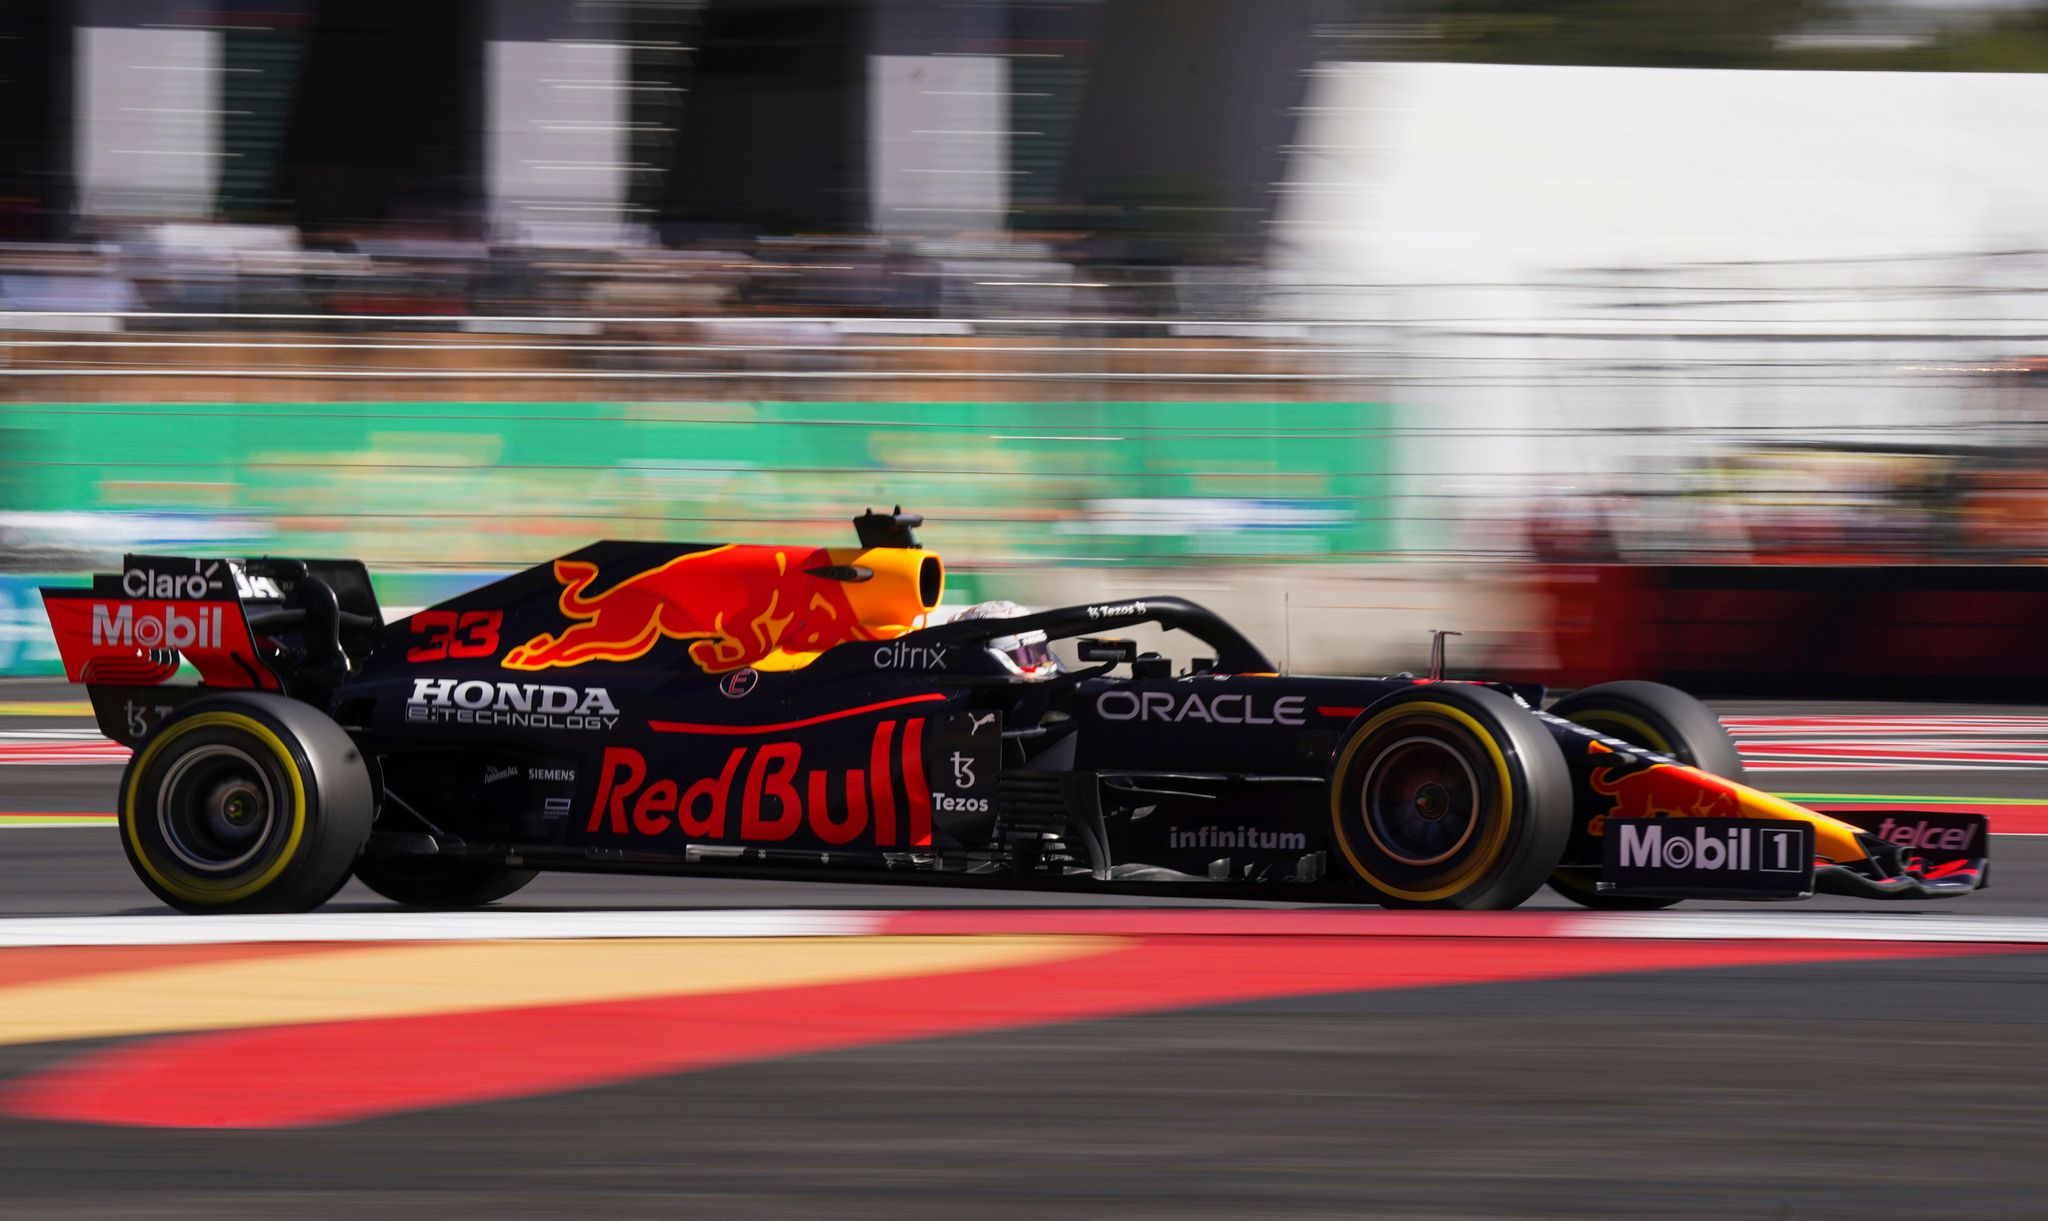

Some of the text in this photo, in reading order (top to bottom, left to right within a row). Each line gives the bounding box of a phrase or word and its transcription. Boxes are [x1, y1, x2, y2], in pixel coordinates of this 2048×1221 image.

[92, 603, 223, 648] Mobil
[1100, 605, 1134, 617] Tezos
[407, 609, 503, 663] 33
[873, 641, 948, 670] citrix
[407, 678, 620, 715] HONDA
[1096, 691, 1307, 725] ORACLE
[529, 768, 576, 781] SIEMENS
[932, 792, 989, 813] Tezos
[1170, 826, 1306, 849] infinitum
[1619, 824, 1788, 871] Mobil 1
[1878, 817, 1979, 851] telcel
